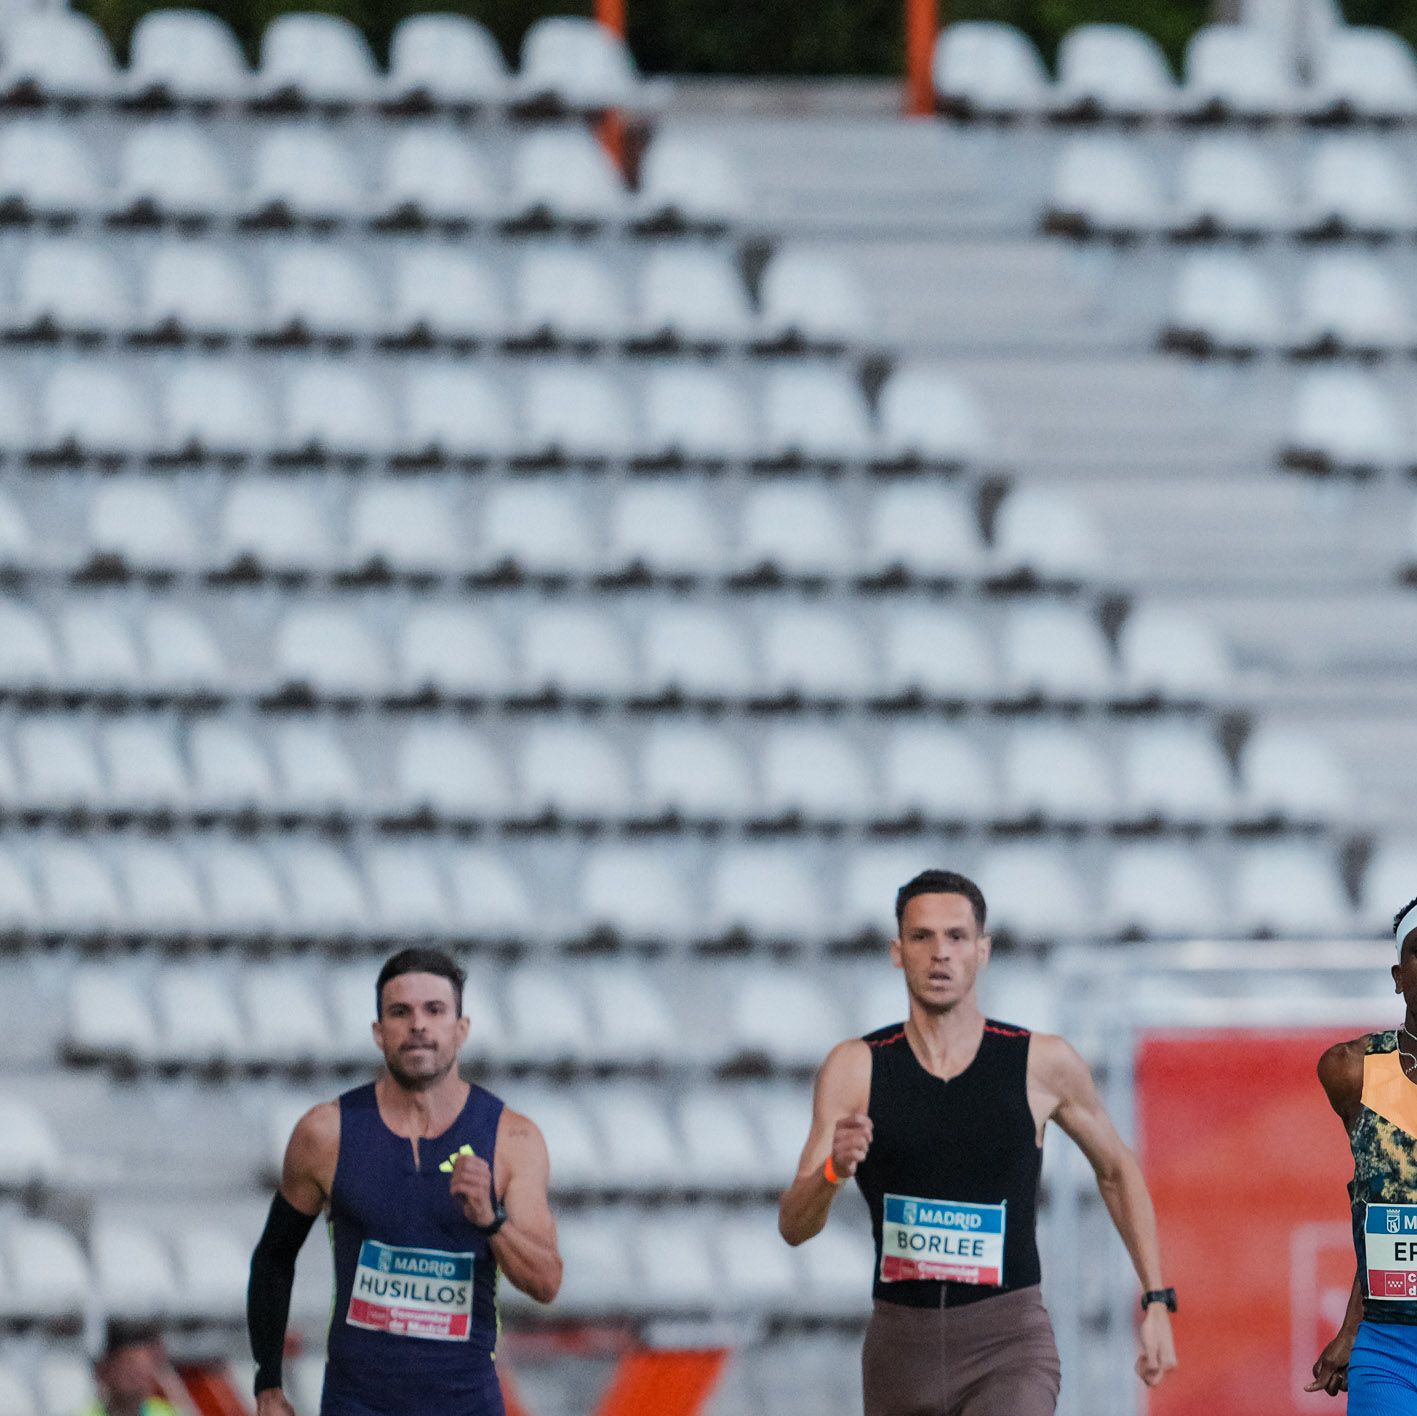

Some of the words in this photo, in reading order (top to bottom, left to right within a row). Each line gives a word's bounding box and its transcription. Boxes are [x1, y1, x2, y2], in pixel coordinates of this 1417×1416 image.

[919, 1208, 982, 1231] MADRID
[897, 1230, 985, 1257] BORLEE
[394, 1257, 456, 1278] MADRID
[360, 1273, 467, 1306] HUSILLOS
